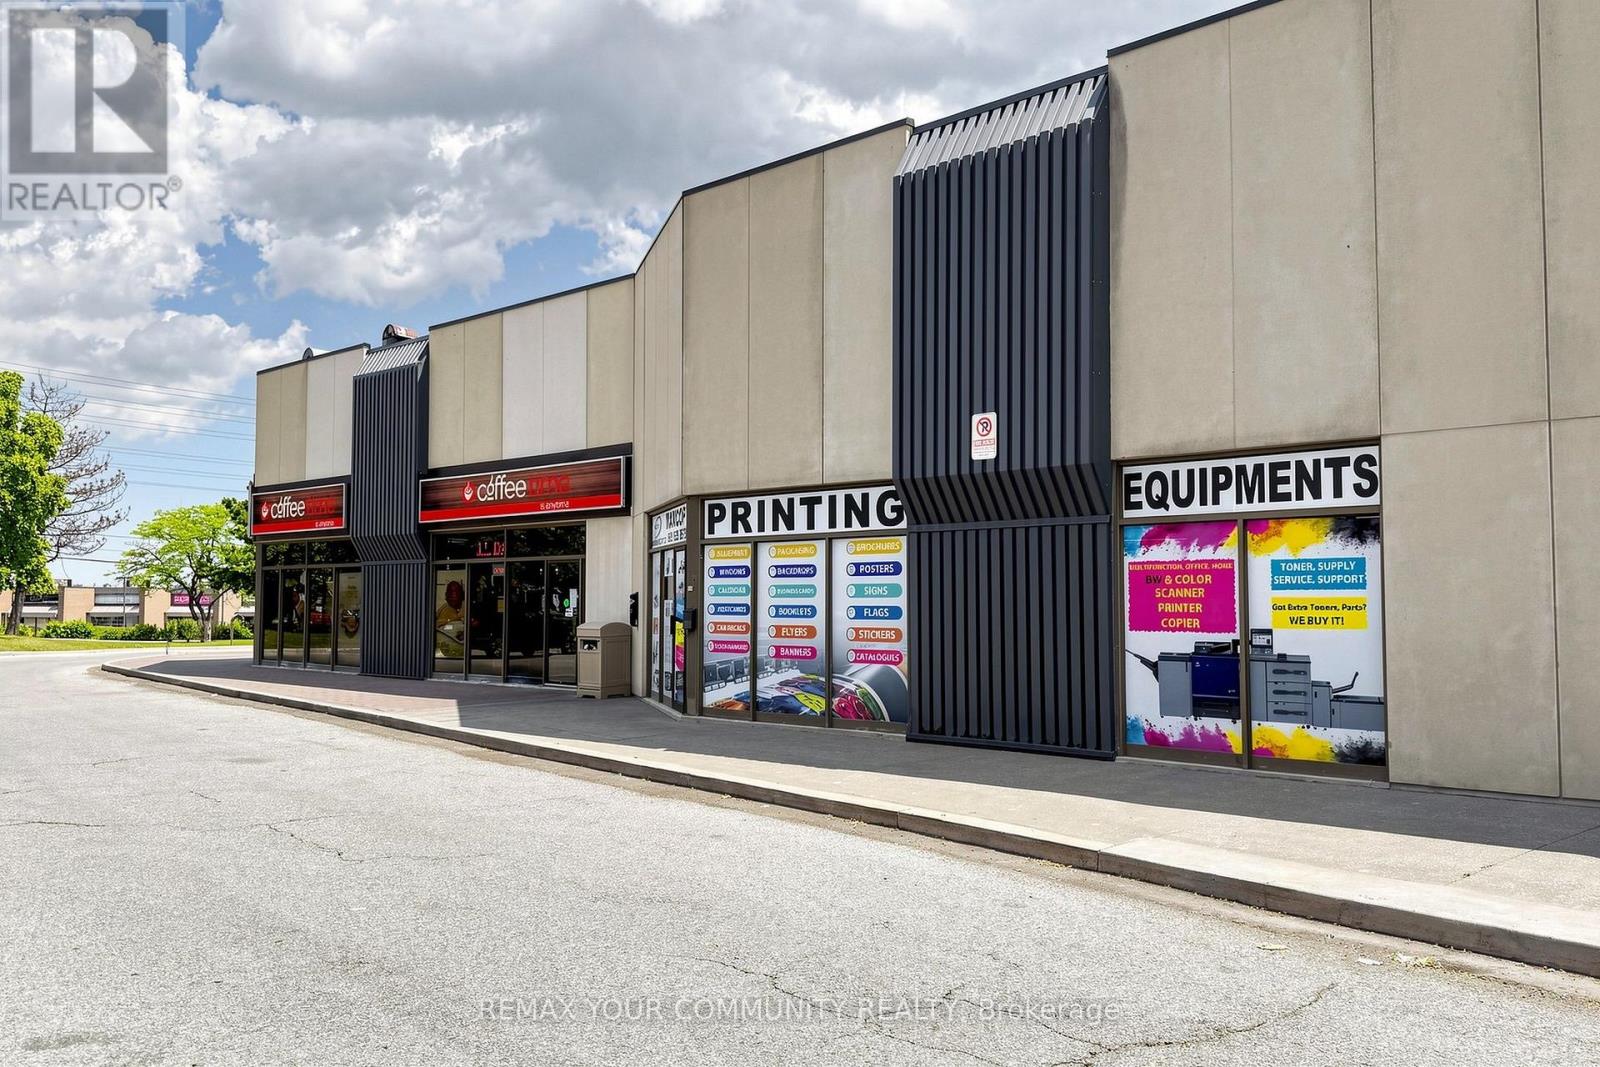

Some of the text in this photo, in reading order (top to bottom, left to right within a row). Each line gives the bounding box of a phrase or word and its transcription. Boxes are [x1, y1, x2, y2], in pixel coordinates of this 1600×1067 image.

[476, 473, 528, 502] coffee
[1123, 453, 1380, 512] EQUIPMENTS
[270, 495, 306, 519] coffee
[707, 489, 905, 535] PRINTING
[856, 541, 900, 551] BROCHURES
[777, 567, 814, 575] BACKDROPS
[859, 564, 895, 573] POSTERS
[1212, 562, 1233, 570] HOME
[1317, 561, 1356, 571] SUPPLY
[1145, 574, 1212, 585] BW & COLOR
[1317, 574, 1365, 584] SUPPORT
[863, 586, 888, 596] SIGNS
[1155, 588, 1205, 598] SCANNER
[778, 607, 812, 616] BOOKLETS
[1158, 603, 1203, 613] PRINTER
[1272, 603, 1287, 611] Got
[1287, 603, 1308, 611] Extra
[1341, 603, 1367, 611] Parts?
[863, 608, 889, 617] FLAGS
[1161, 618, 1200, 628] COPIER
[1289, 616, 1345, 626] WE BUY IT!
[781, 627, 808, 637] FLYERS
[858, 629, 896, 639] STICKERS
[780, 647, 811, 657] BANNERS
[855, 653, 900, 662] CATALOGUES
